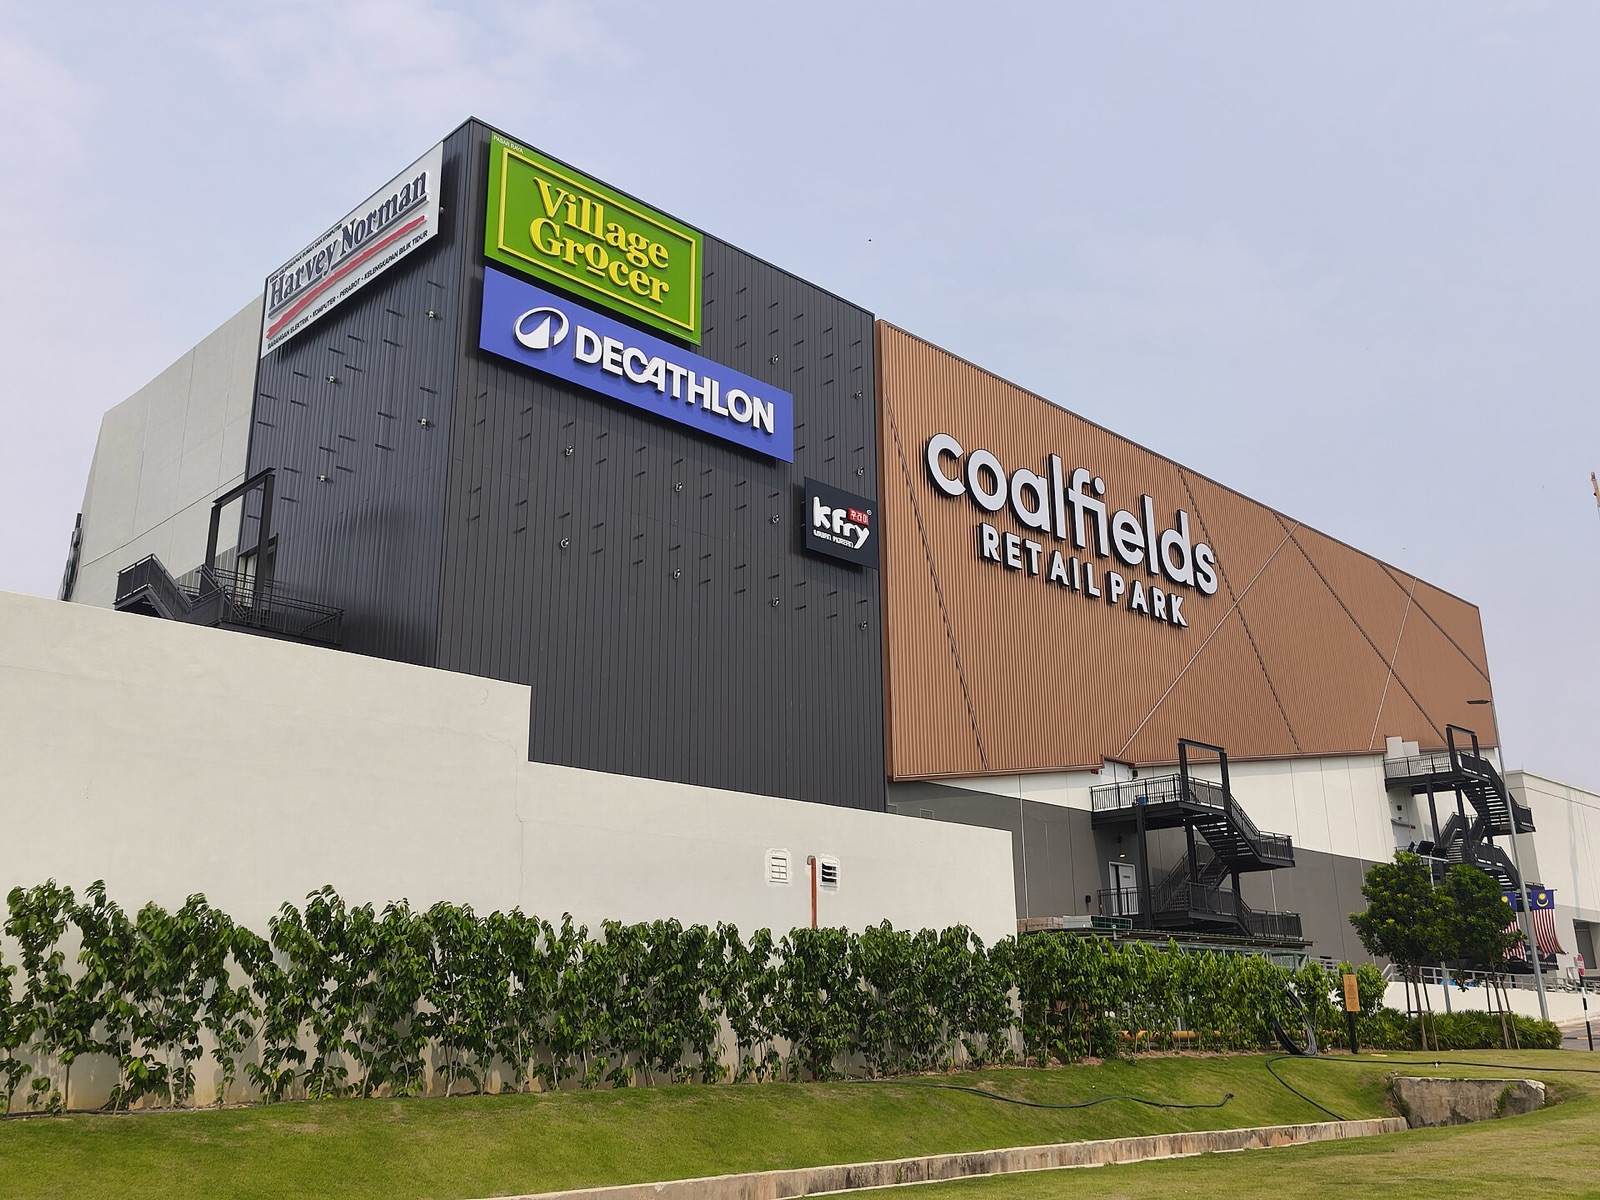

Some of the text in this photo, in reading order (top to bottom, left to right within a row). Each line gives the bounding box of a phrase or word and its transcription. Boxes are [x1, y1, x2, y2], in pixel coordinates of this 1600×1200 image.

[268, 171, 427, 311] Harvey Norman
[312, 296, 336, 317] KOMPUTER
[339, 277, 361, 298] PERABOT
[363, 250, 398, 280] KELENGKAPAN
[411, 230, 428, 246] TIDUR
[529, 217, 670, 304] Grocer
[532, 176, 669, 269] Village
[573, 324, 775, 435] DECATHLON
[926, 432, 1219, 596] coalfields
[977, 521, 1189, 628] RETAIL PARK
